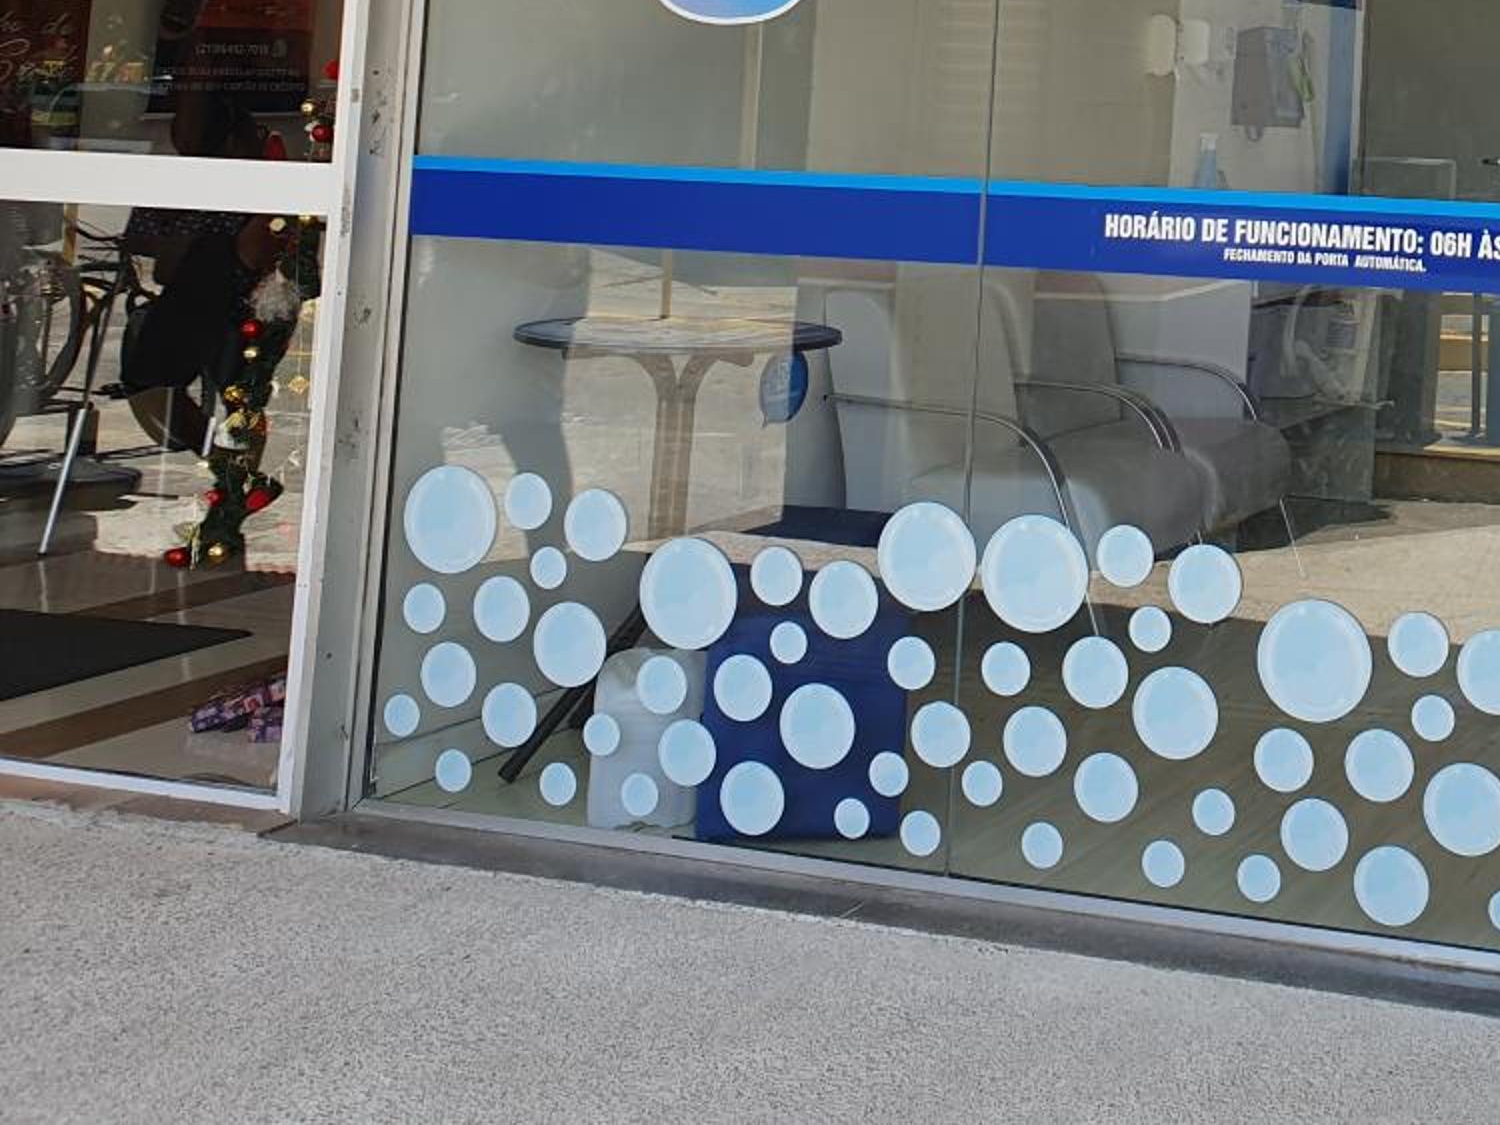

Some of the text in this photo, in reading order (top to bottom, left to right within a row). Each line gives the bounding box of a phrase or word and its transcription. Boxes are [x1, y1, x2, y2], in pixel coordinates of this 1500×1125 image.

[1104, 212, 1196, 242] HORÁRIO
[1202, 217, 1228, 244] DE
[1235, 219, 1425, 255] FUNCIONAMENTO:
[1430, 230, 1471, 259] 06H
[1223, 248, 1295, 265] FECHAMENTO
[1315, 252, 1348, 268] PORTA
